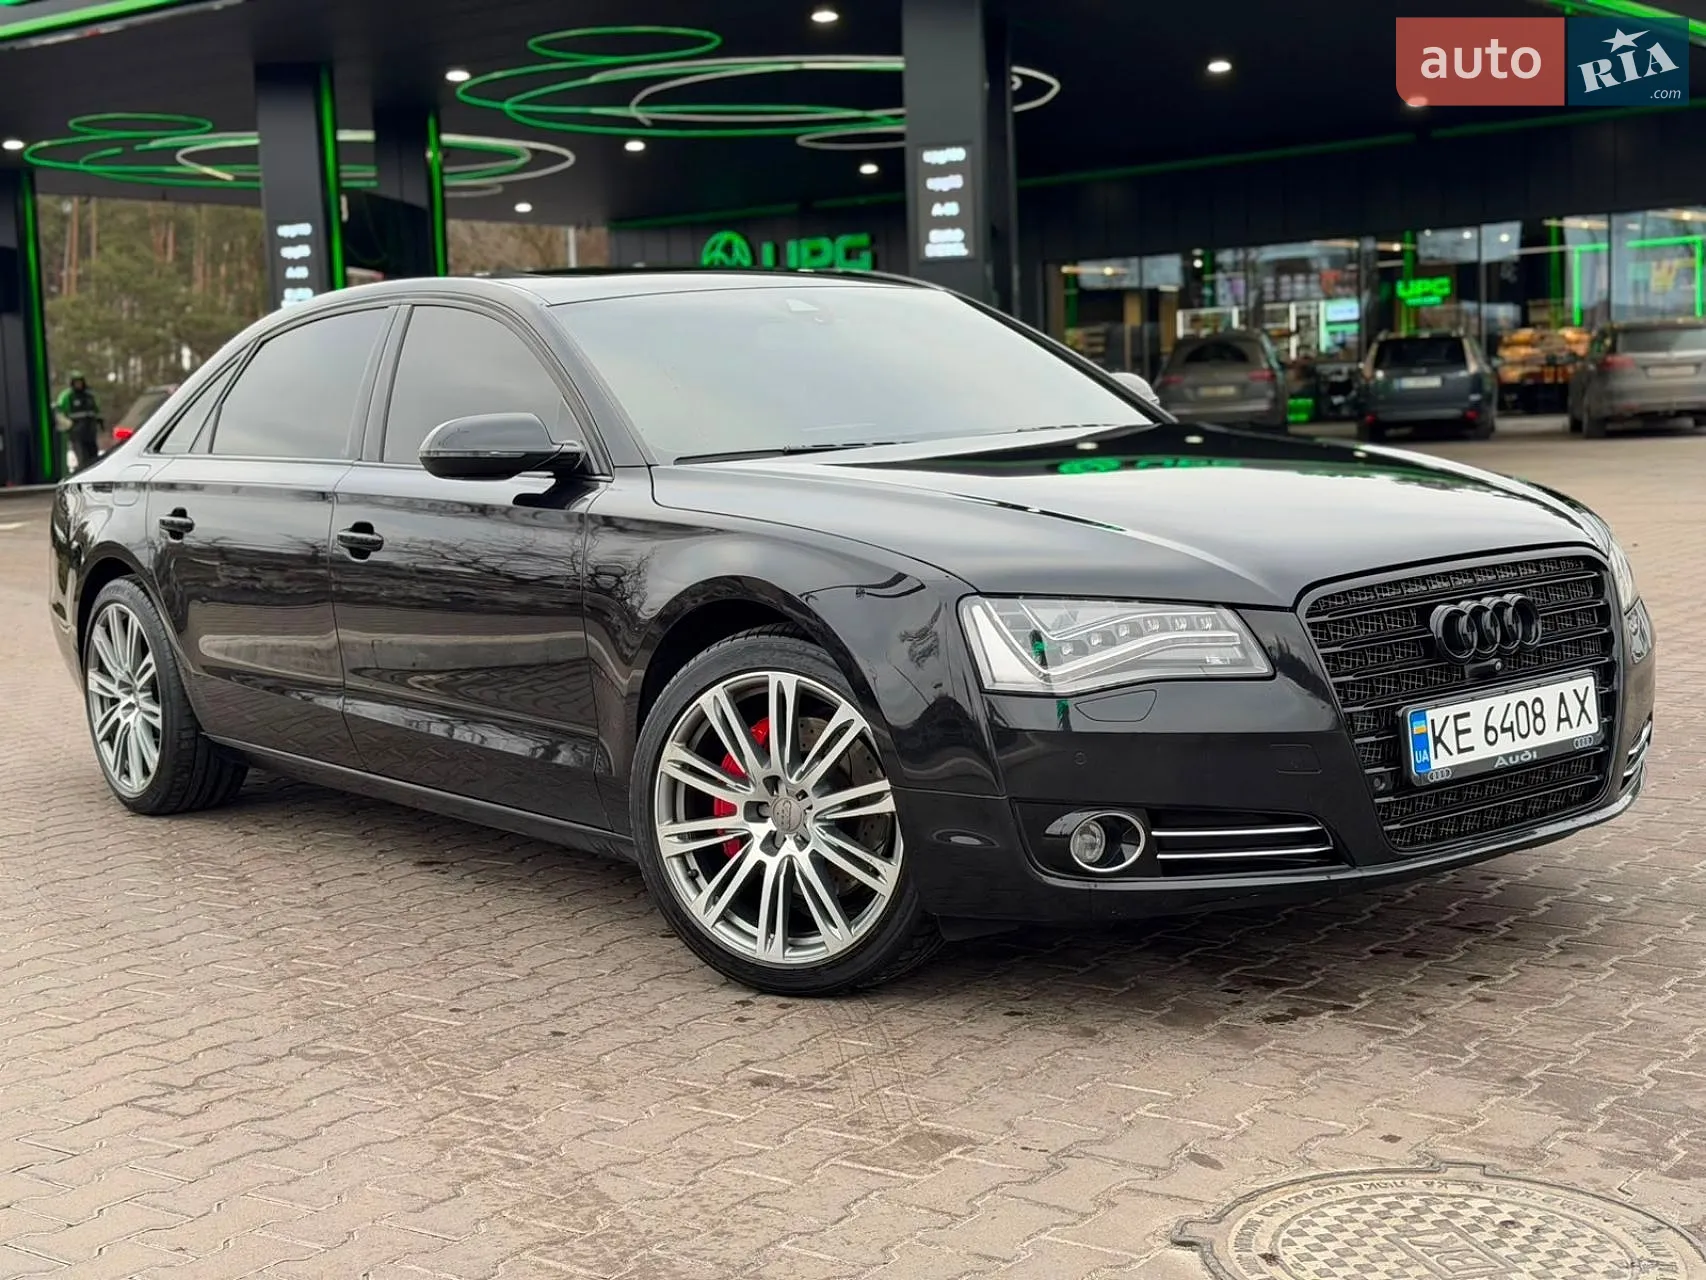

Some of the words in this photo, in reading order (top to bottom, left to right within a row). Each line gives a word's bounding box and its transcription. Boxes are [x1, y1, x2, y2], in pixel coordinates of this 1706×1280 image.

[1430, 711, 1476, 760] KE
[1483, 696, 1547, 747] 6408
[1556, 685, 1593, 733] AX
[1414, 750, 1431, 765] UA
[1493, 750, 1538, 769] Audi
